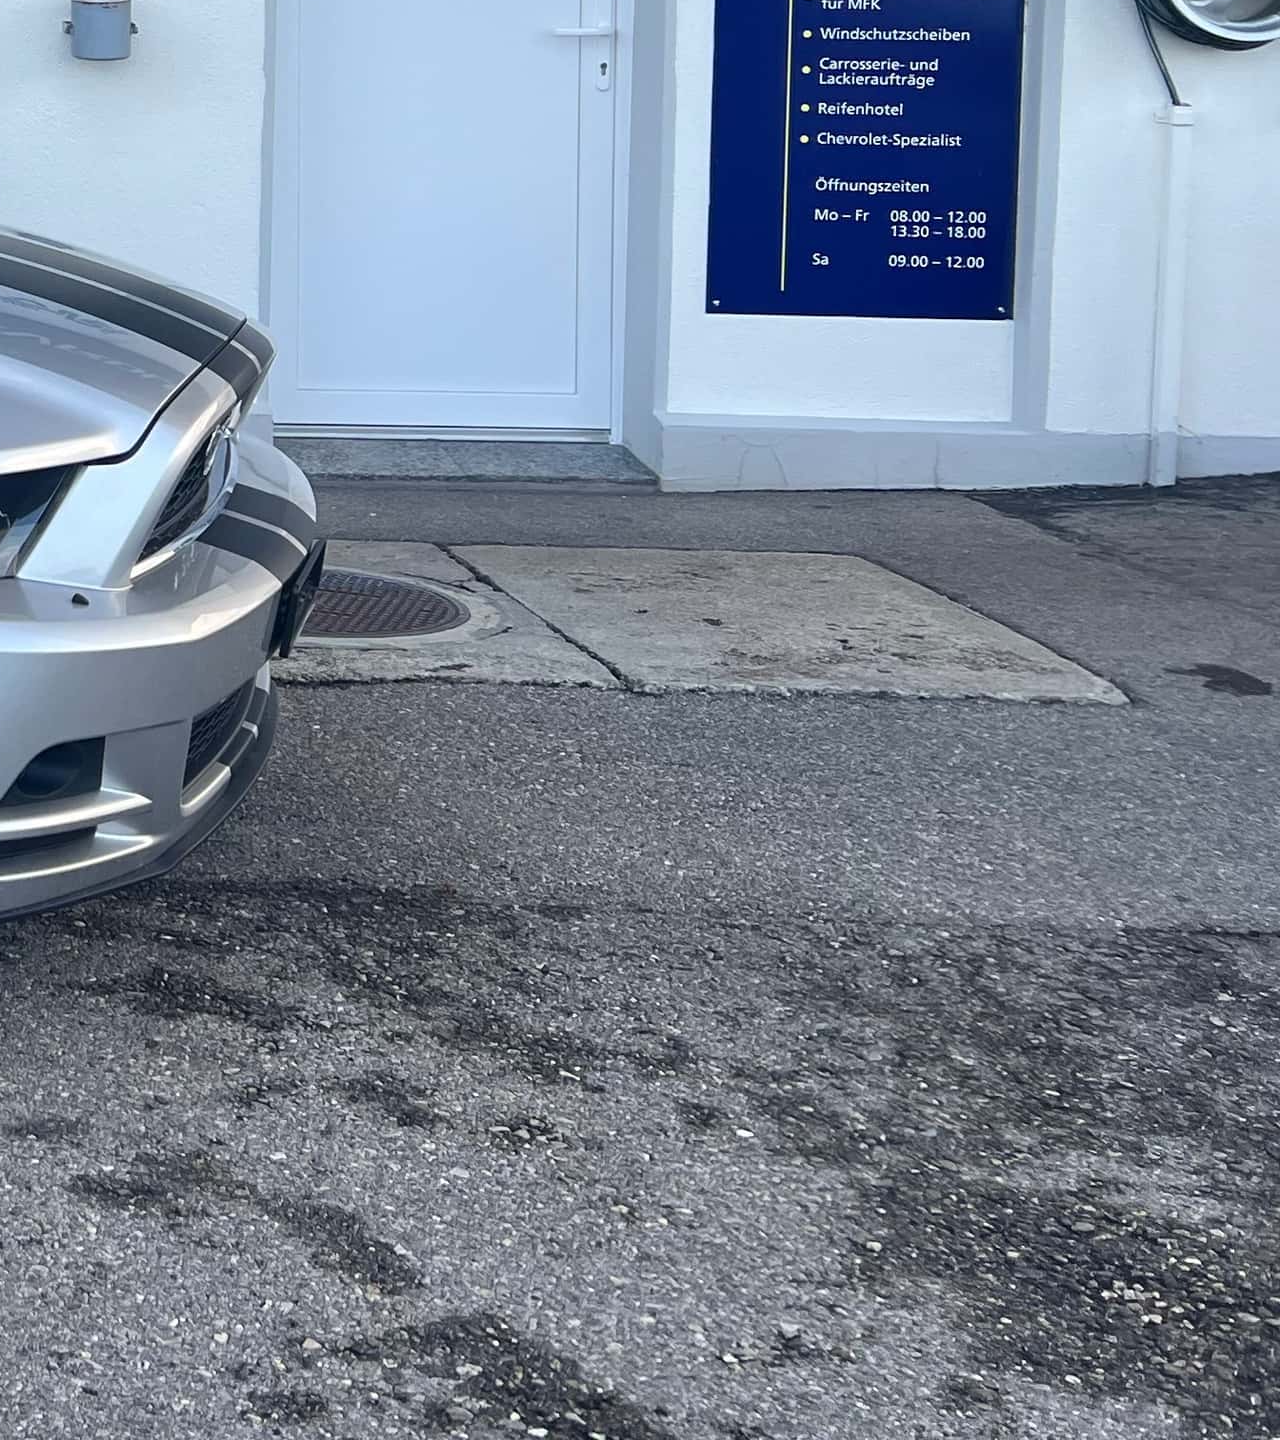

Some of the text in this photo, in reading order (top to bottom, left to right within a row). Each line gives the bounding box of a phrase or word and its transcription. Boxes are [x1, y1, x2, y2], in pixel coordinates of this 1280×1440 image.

[820, 28, 971, 41] Windschutzscheiben
[819, 57, 938, 71] Carrosserie- und
[819, 72, 935, 88] Lackieraufträge
[818, 103, 904, 116] Reifenhotel
[817, 132, 962, 148] Chevrolet-Spezialist
[815, 176, 930, 194] Öffnungszeiten
[814, 209, 839, 221] Mo
[855, 209, 870, 221] Fr
[890, 211, 930, 223] 08.00
[947, 211, 987, 224] 12.00
[890, 225, 929, 238] 13.30
[946, 226, 986, 239] 18.00
[812, 253, 829, 266] Sa
[888, 255, 928, 268] 09.00
[946, 256, 985, 269] 12.00
